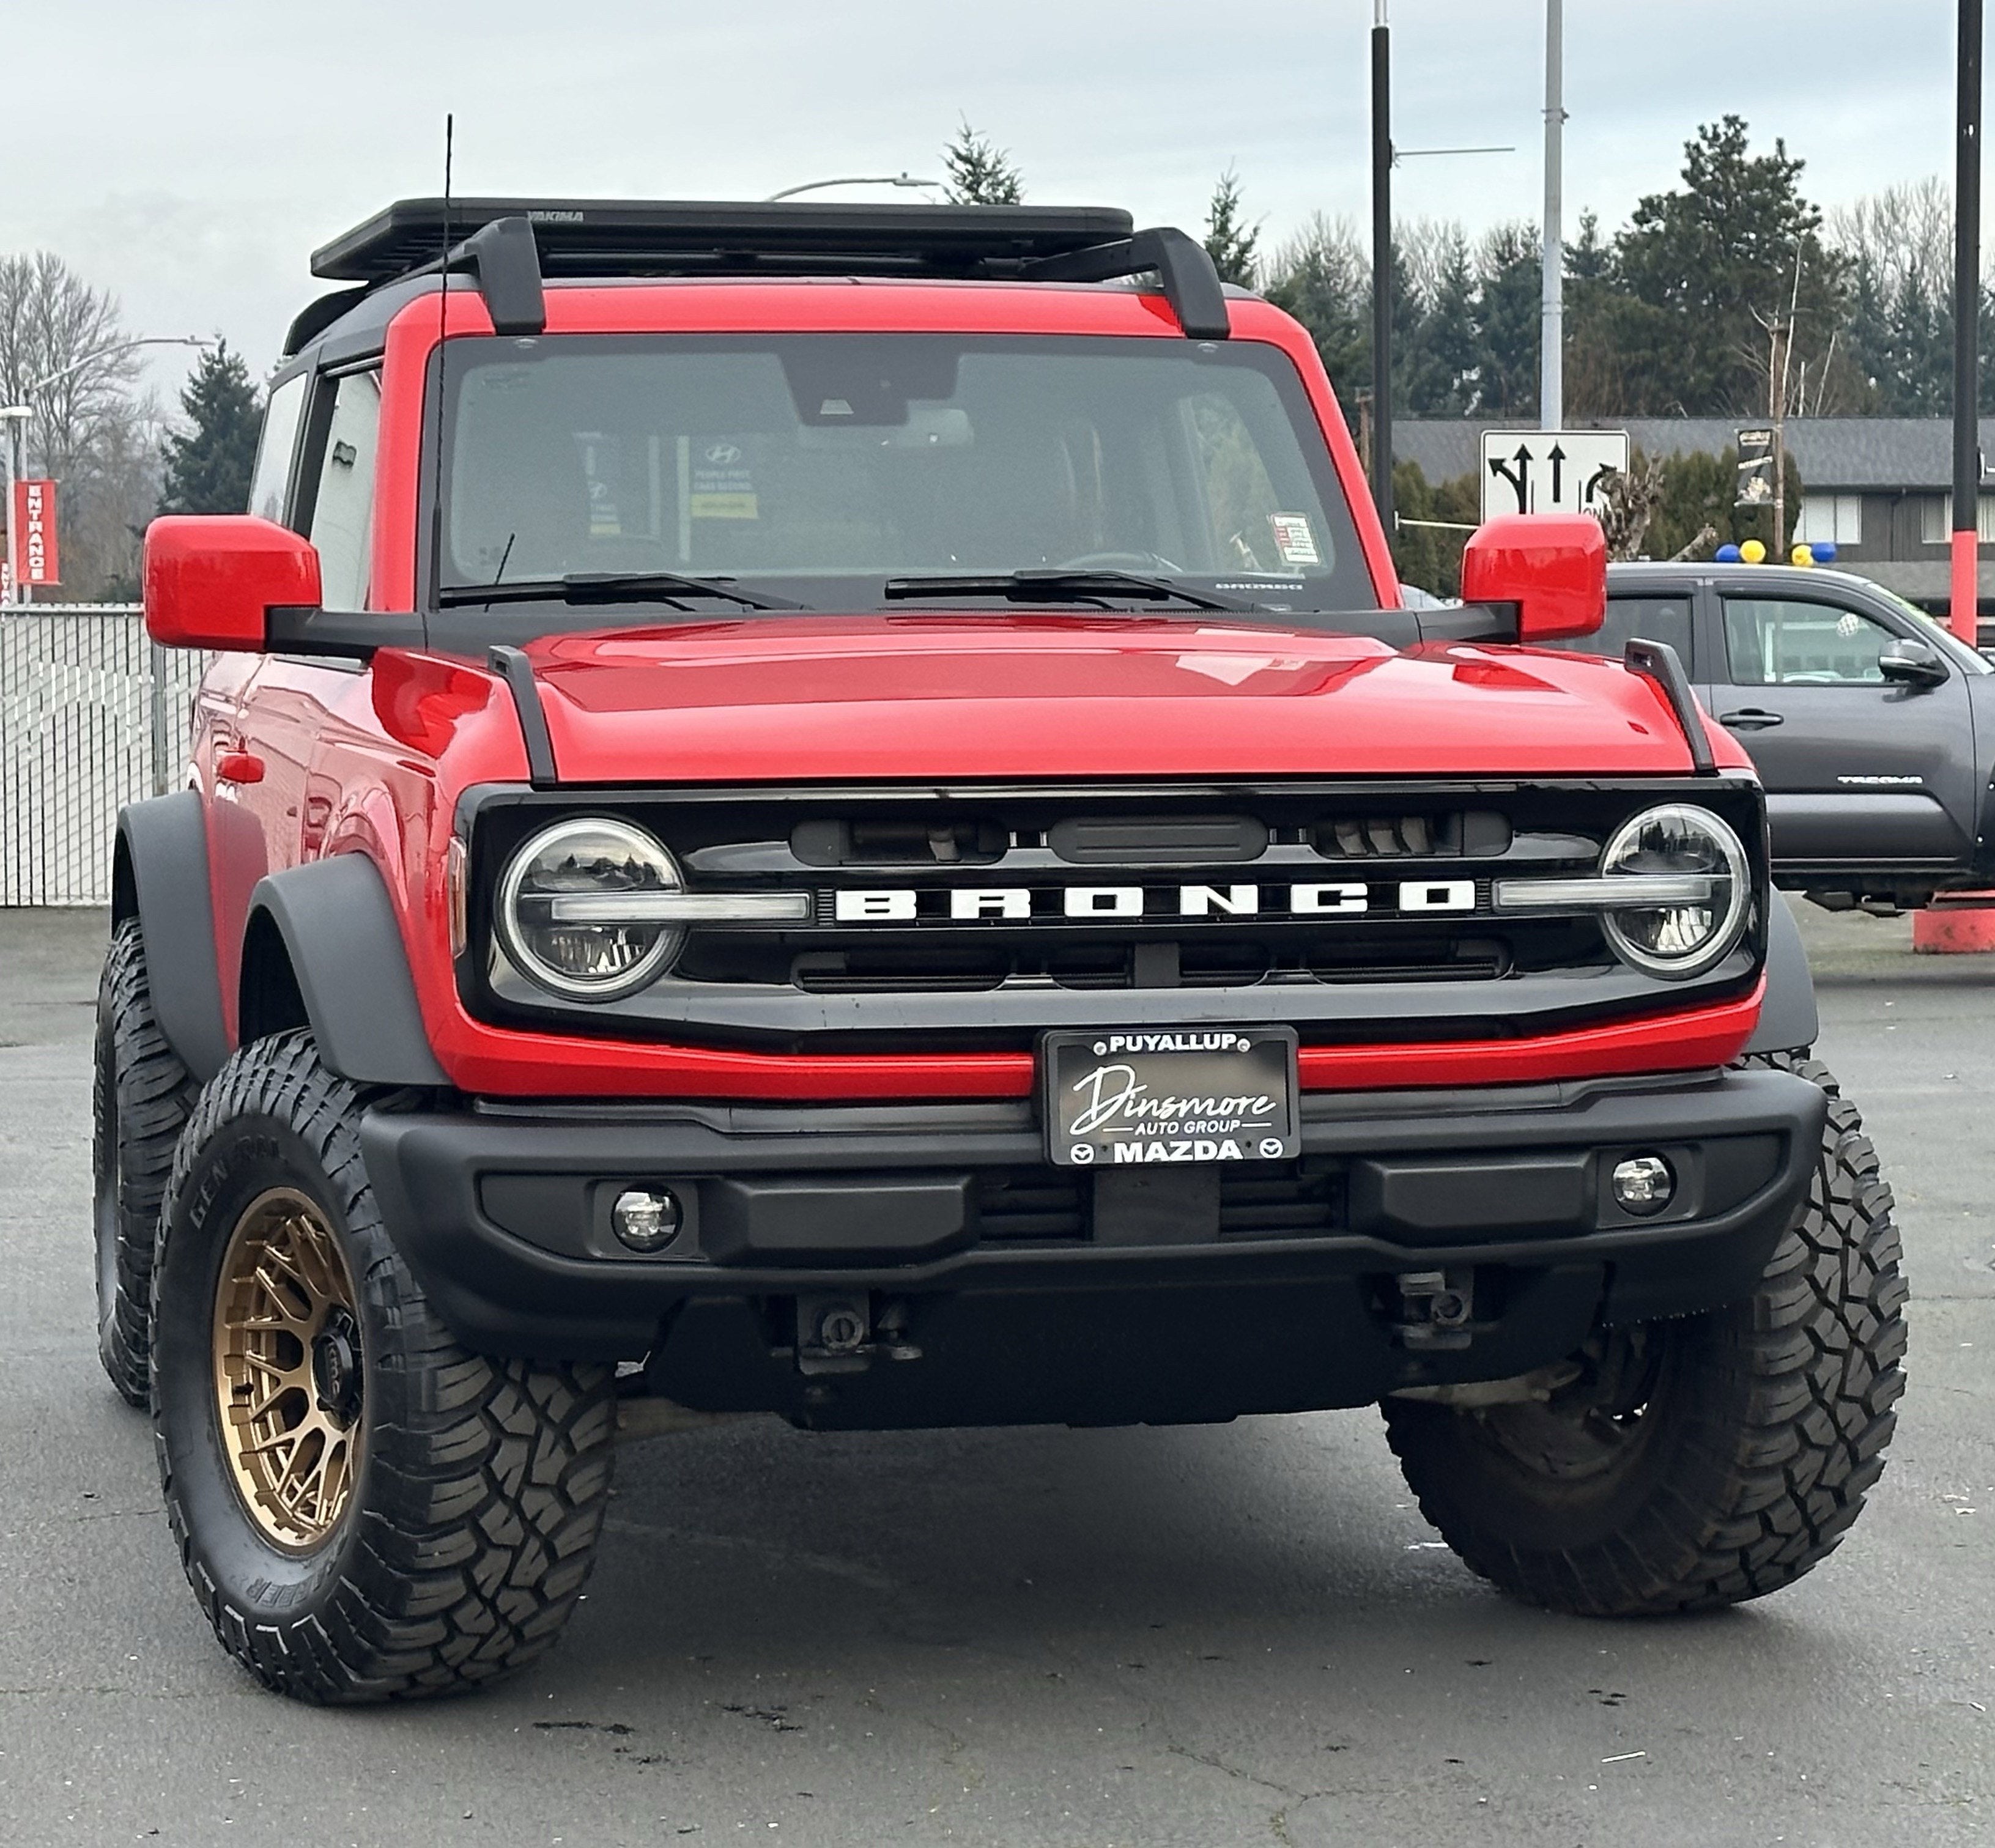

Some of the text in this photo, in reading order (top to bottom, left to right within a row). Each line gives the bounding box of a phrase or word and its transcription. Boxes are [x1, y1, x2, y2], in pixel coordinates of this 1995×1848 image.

[527, 210, 583, 222] YAKIMA
[28, 485, 44, 580] ENTRANCE
[835, 881, 1475, 920] BRONCO
[1109, 1033, 1237, 1052] PUYALLUP
[1069, 1065, 1276, 1136] Dinsmore
[1134, 1119, 1241, 1136] AUTO GROUP
[1113, 1139, 1243, 1164] MAZDA
